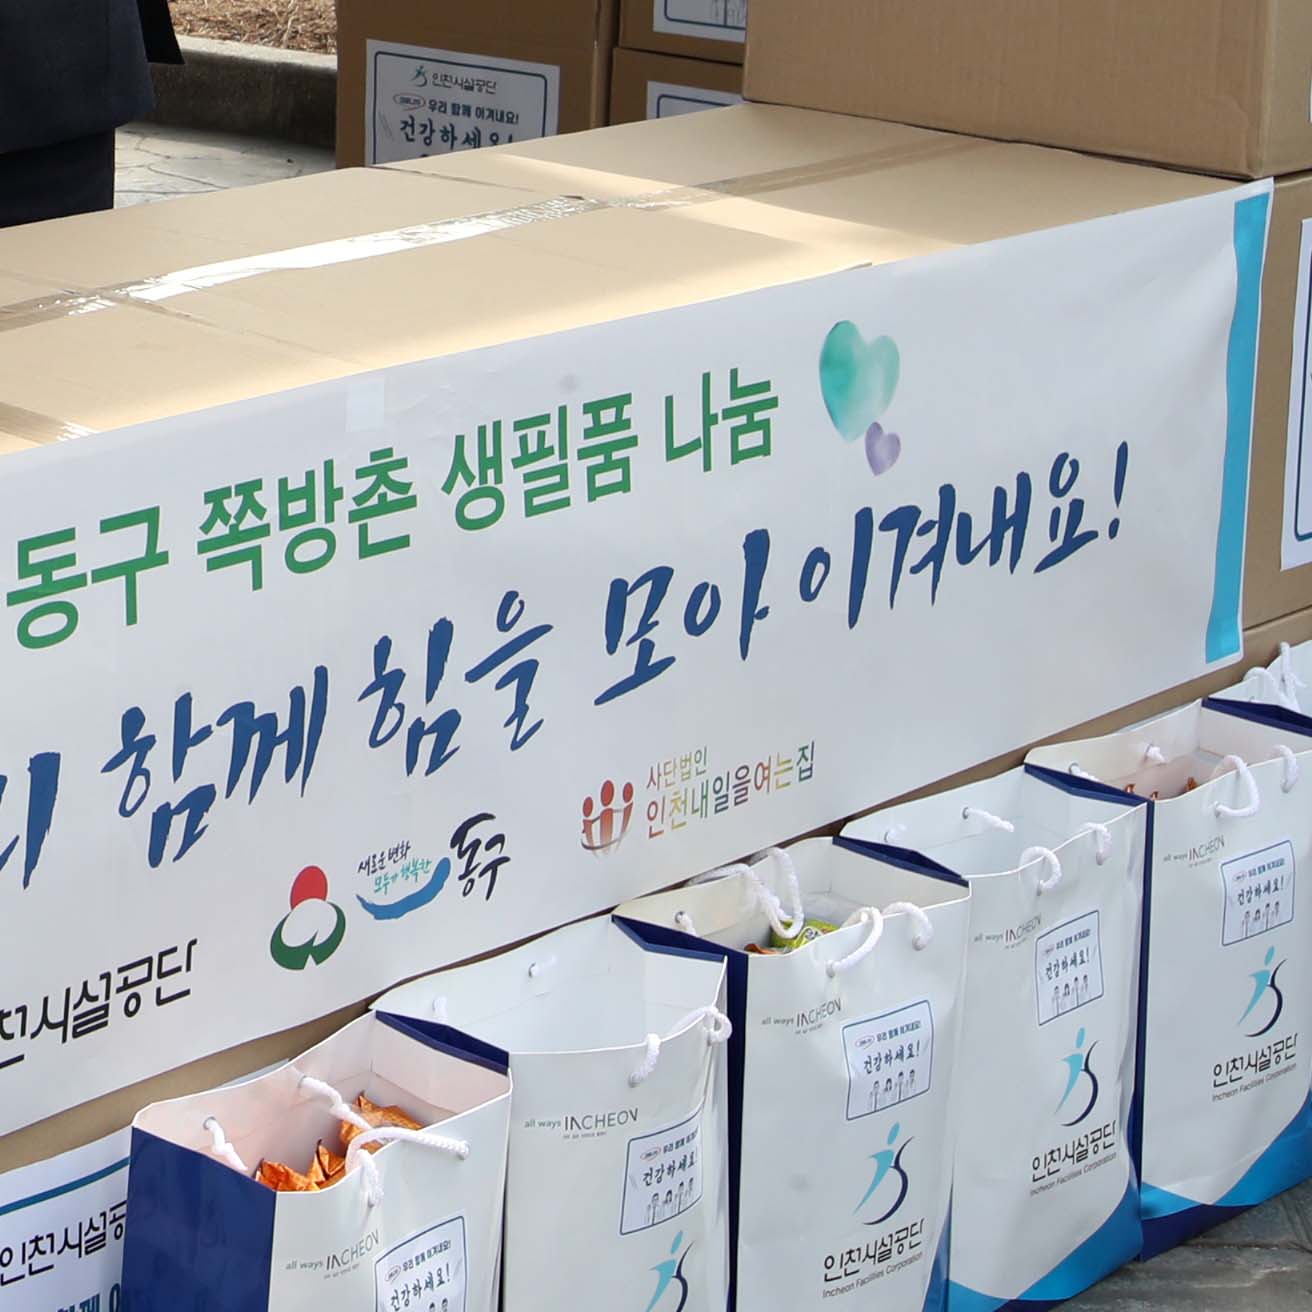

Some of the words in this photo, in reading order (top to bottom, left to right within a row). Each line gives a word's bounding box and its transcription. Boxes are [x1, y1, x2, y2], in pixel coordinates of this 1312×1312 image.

[432, 73, 497, 94] 인천시설공단
[428, 99, 447, 114] 우리
[451, 102, 471, 118] 함께
[475, 107, 519, 124] 이겨내요!
[6, 505, 169, 650] 동구
[196, 447, 418, 593] 쪽방촌
[441, 392, 638, 531] 생필품
[663, 367, 779, 482] 나눔
[100, 665, 329, 868] 함께
[357, 590, 554, 777] 힘을
[594, 528, 771, 707] 모아
[798, 441, 1128, 630] 이겨내요!
[646, 746, 708, 791] 사단법인
[646, 740, 815, 839] 인천내일을여는집
[357, 851, 387, 877] 새로운
[388, 840, 412, 864] 변화
[400, 857, 432, 883] 행복한
[449, 812, 511, 902] 동구
[863, 1039, 920, 1075] 건강하세요!
[1213, 1032, 1298, 1088] 인천시설공단
[524, 1119, 536, 1128] all
[537, 1120, 562, 1130] ways
[1032, 1120, 1116, 1182] 인천시설공단
[0, 1200, 127, 1286] 인천시설공
[285, 1259, 297, 1270] all
[299, 1260, 324, 1271] ways
[824, 1218, 925, 1282] 인천시설공단
[390, 1263, 450, 1312] 건강하세요!
[822, 1282, 855, 1299] Incheon
